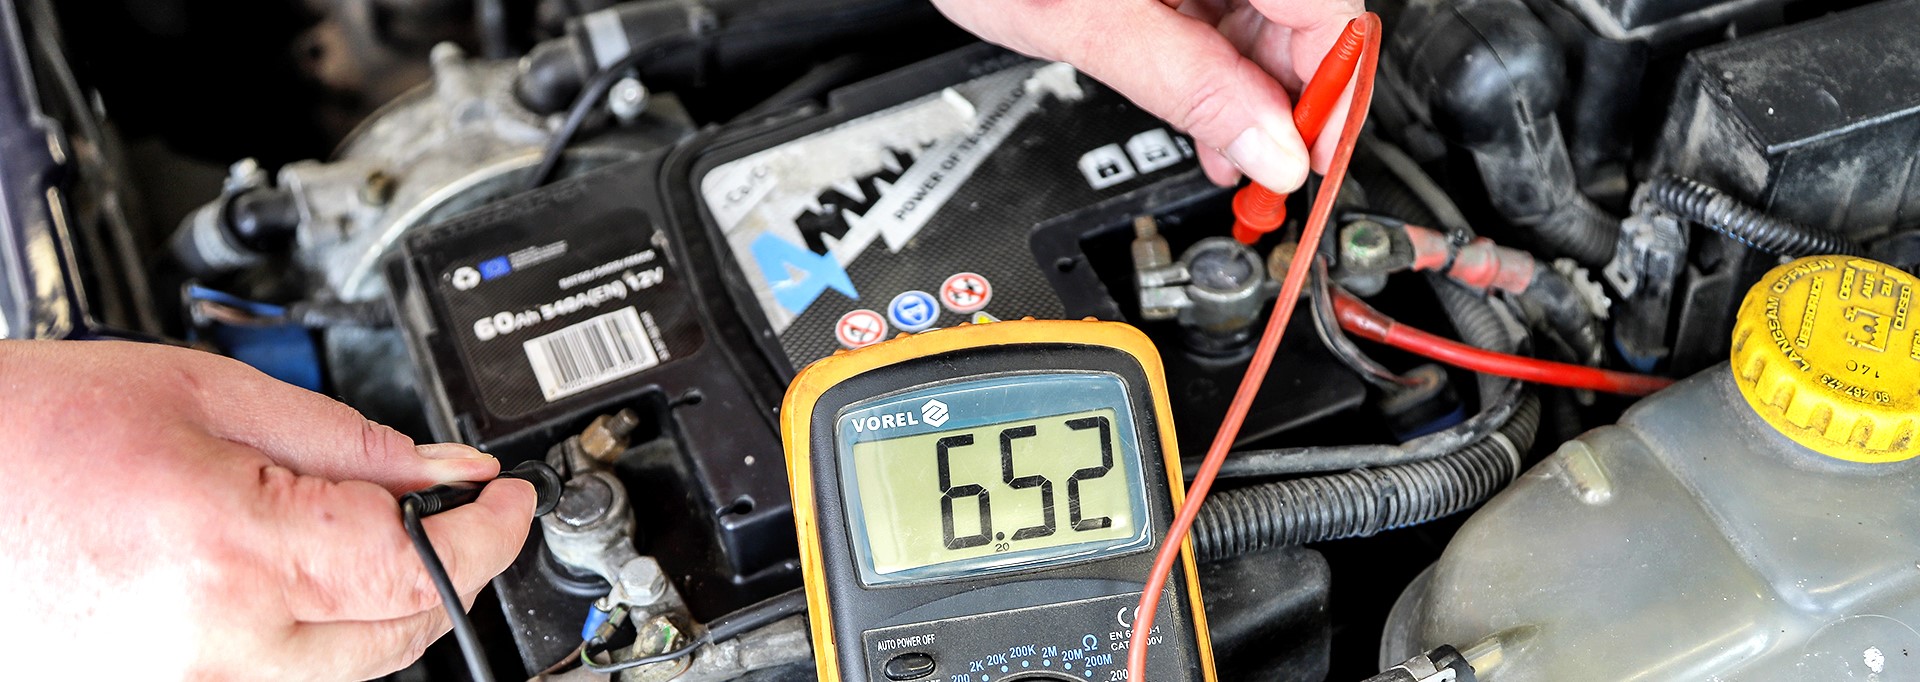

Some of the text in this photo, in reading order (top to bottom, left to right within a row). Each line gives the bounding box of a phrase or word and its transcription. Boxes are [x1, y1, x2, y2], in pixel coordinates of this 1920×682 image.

[894, 172, 943, 220] POWER
[941, 154, 961, 171] OF
[1839, 266, 1856, 300] OPEN
[1862, 272, 1877, 300] AUF
[1881, 278, 1894, 297] ZU
[473, 310, 541, 341] 60Ah
[622, 266, 664, 292] 12V
[1893, 285, 1911, 330] CLOSED
[1766, 296, 1811, 372] LANGSAM
[1821, 374, 1844, 392] 473
[1846, 384, 1870, 400] 467
[851, 410, 919, 433] VOREL
[936, 415, 1114, 550] 6.52
[995, 542, 1010, 552] 20
[877, 633, 936, 652] AUTO POWER OFF
[1109, 631, 1123, 641] EN
[1009, 644, 1037, 659] 200K
[1041, 645, 1058, 658] 2M
[1110, 640, 1130, 651] CAT
[986, 652, 1008, 666] 20K
[1061, 648, 1084, 662] 20M
[1084, 653, 1113, 668] 200M
[969, 660, 985, 673] 2K
